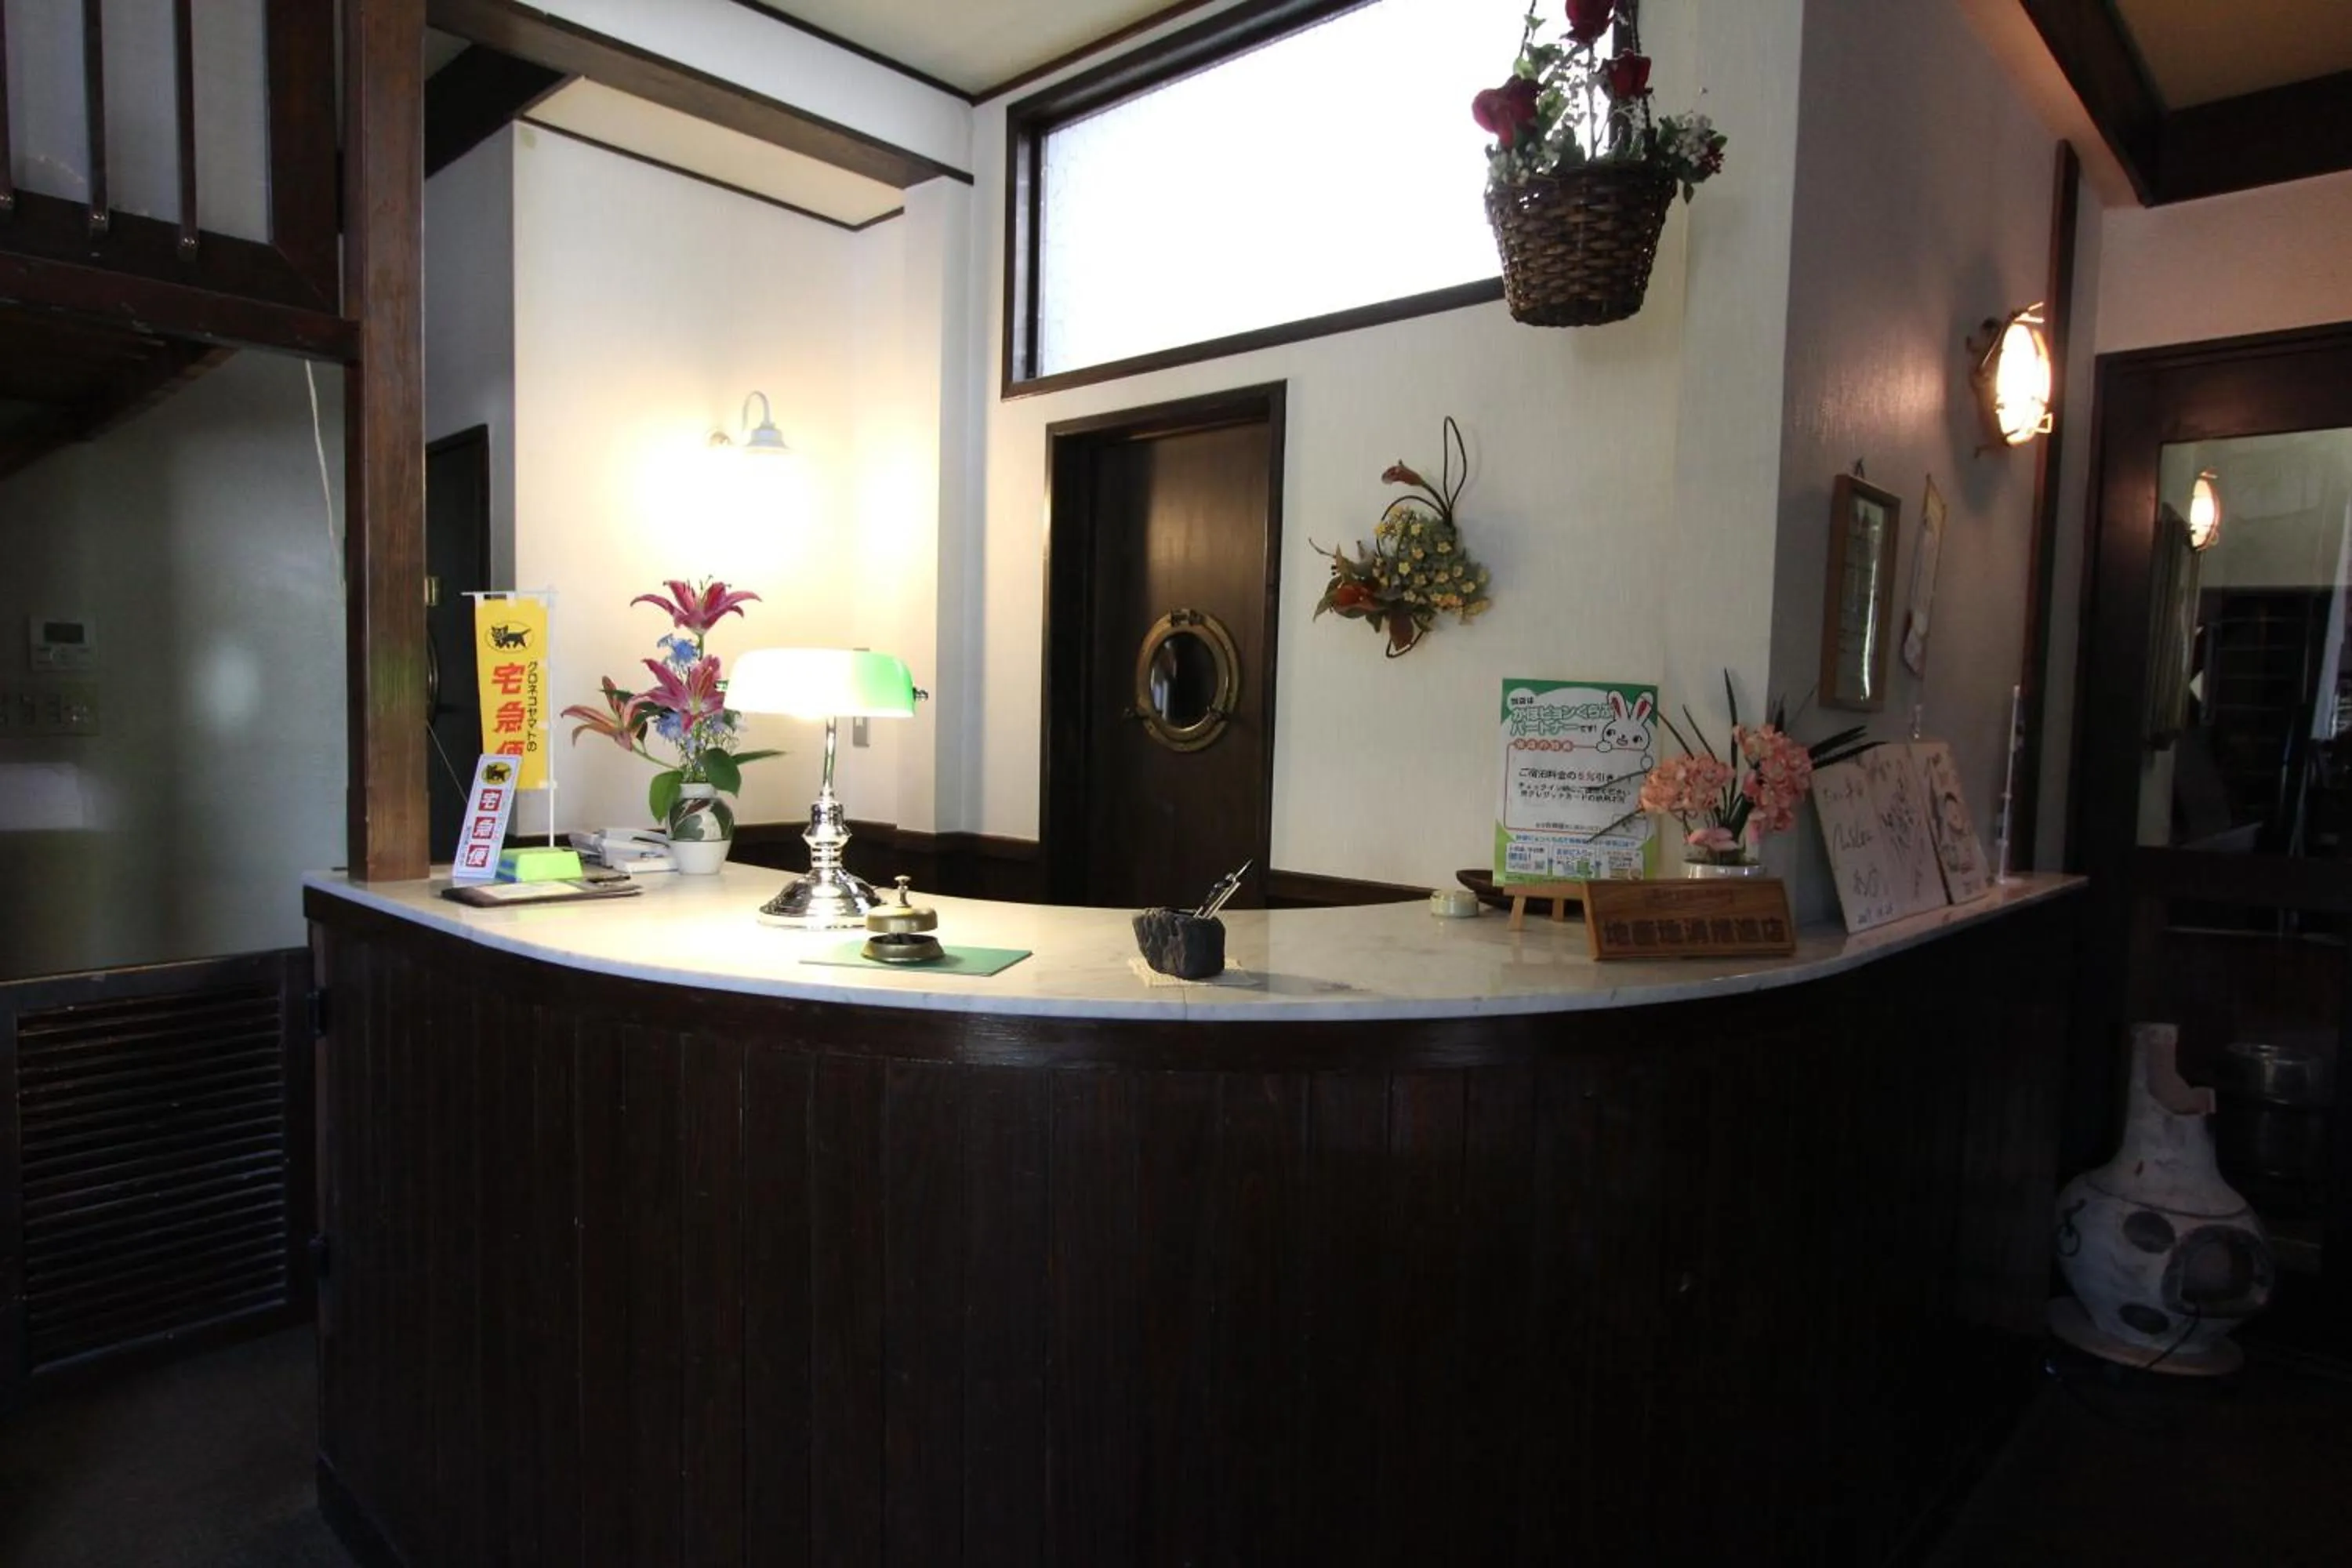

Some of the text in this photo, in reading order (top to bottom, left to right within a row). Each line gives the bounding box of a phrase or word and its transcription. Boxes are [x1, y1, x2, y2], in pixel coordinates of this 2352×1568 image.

[526, 661, 539, 752] クロネコヤマトの
[466, 789, 503, 867] 宅急便
